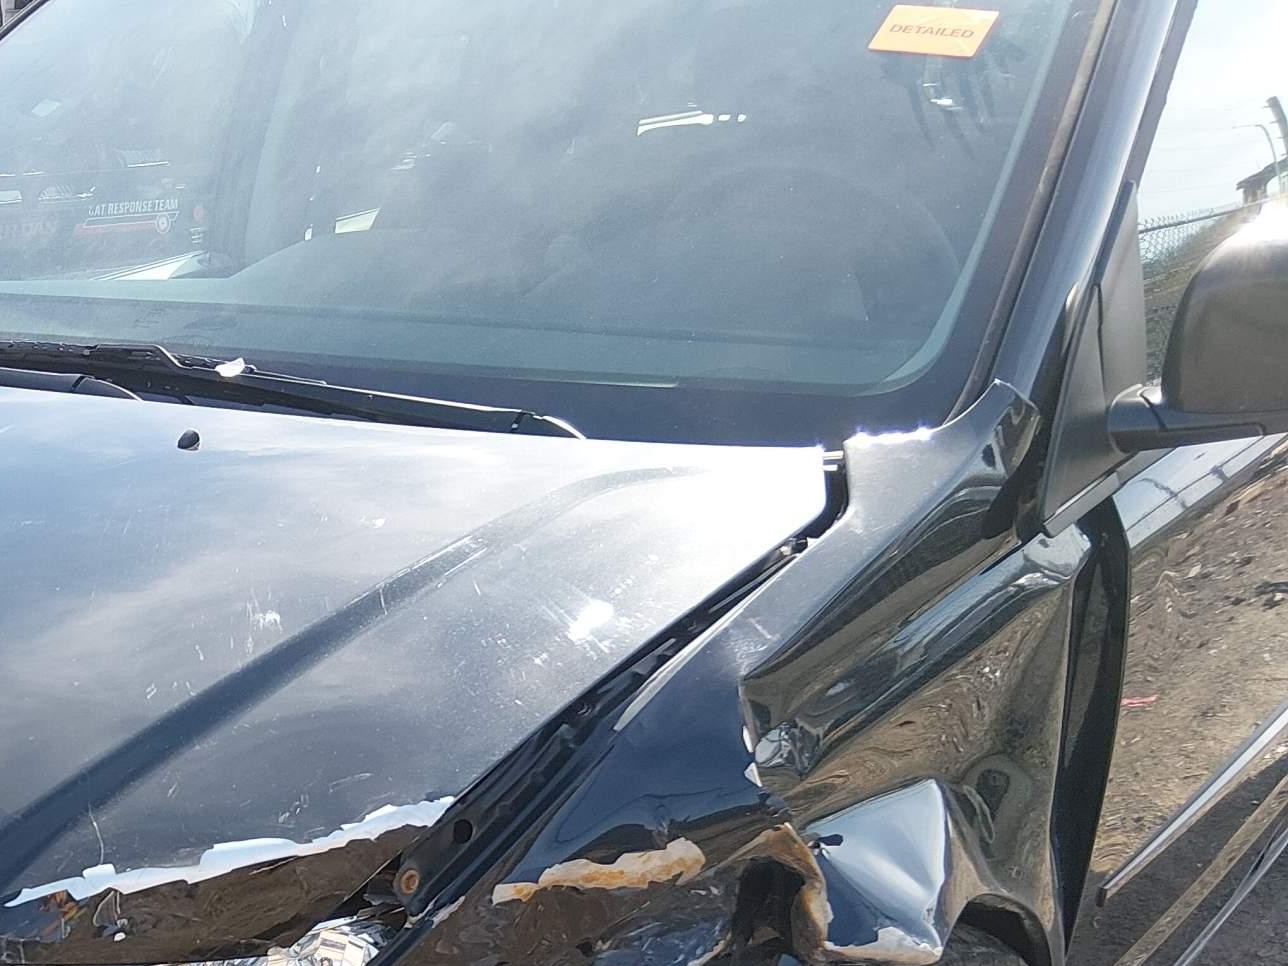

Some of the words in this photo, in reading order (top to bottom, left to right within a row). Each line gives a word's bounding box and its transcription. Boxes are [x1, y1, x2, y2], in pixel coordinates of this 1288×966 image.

[889, 24, 975, 38] DETAILED
[107, 200, 155, 215] RESPONSE
[155, 198, 178, 211] TEAM
